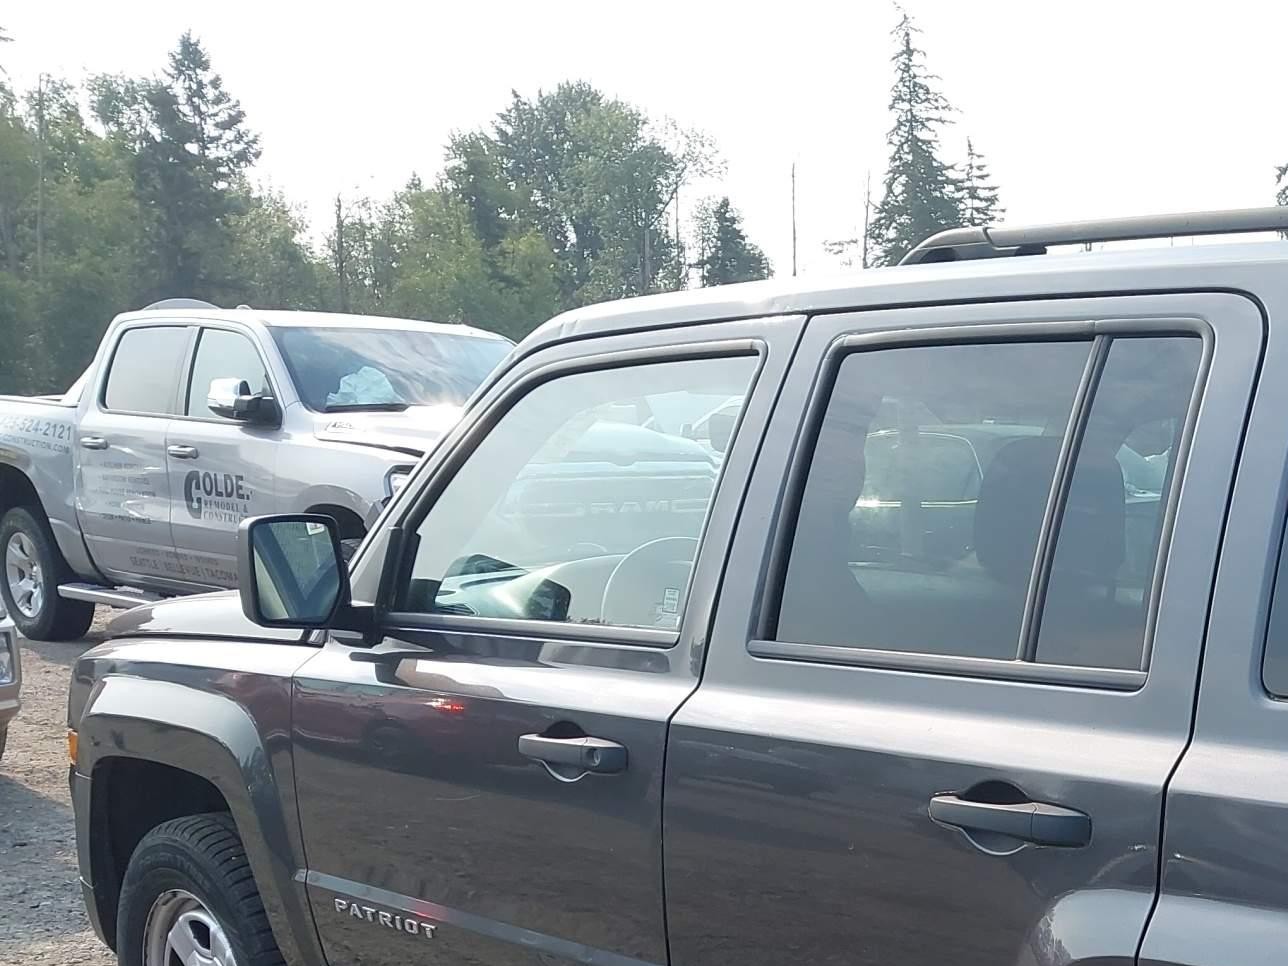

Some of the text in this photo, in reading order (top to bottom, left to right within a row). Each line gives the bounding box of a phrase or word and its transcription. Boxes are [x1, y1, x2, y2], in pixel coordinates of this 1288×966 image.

[0, 414, 72, 441] 25-524-2121
[203, 499, 240, 513] REMODEL
[591, 500, 670, 513] RAM
[334, 898, 438, 939] PATRIOT
